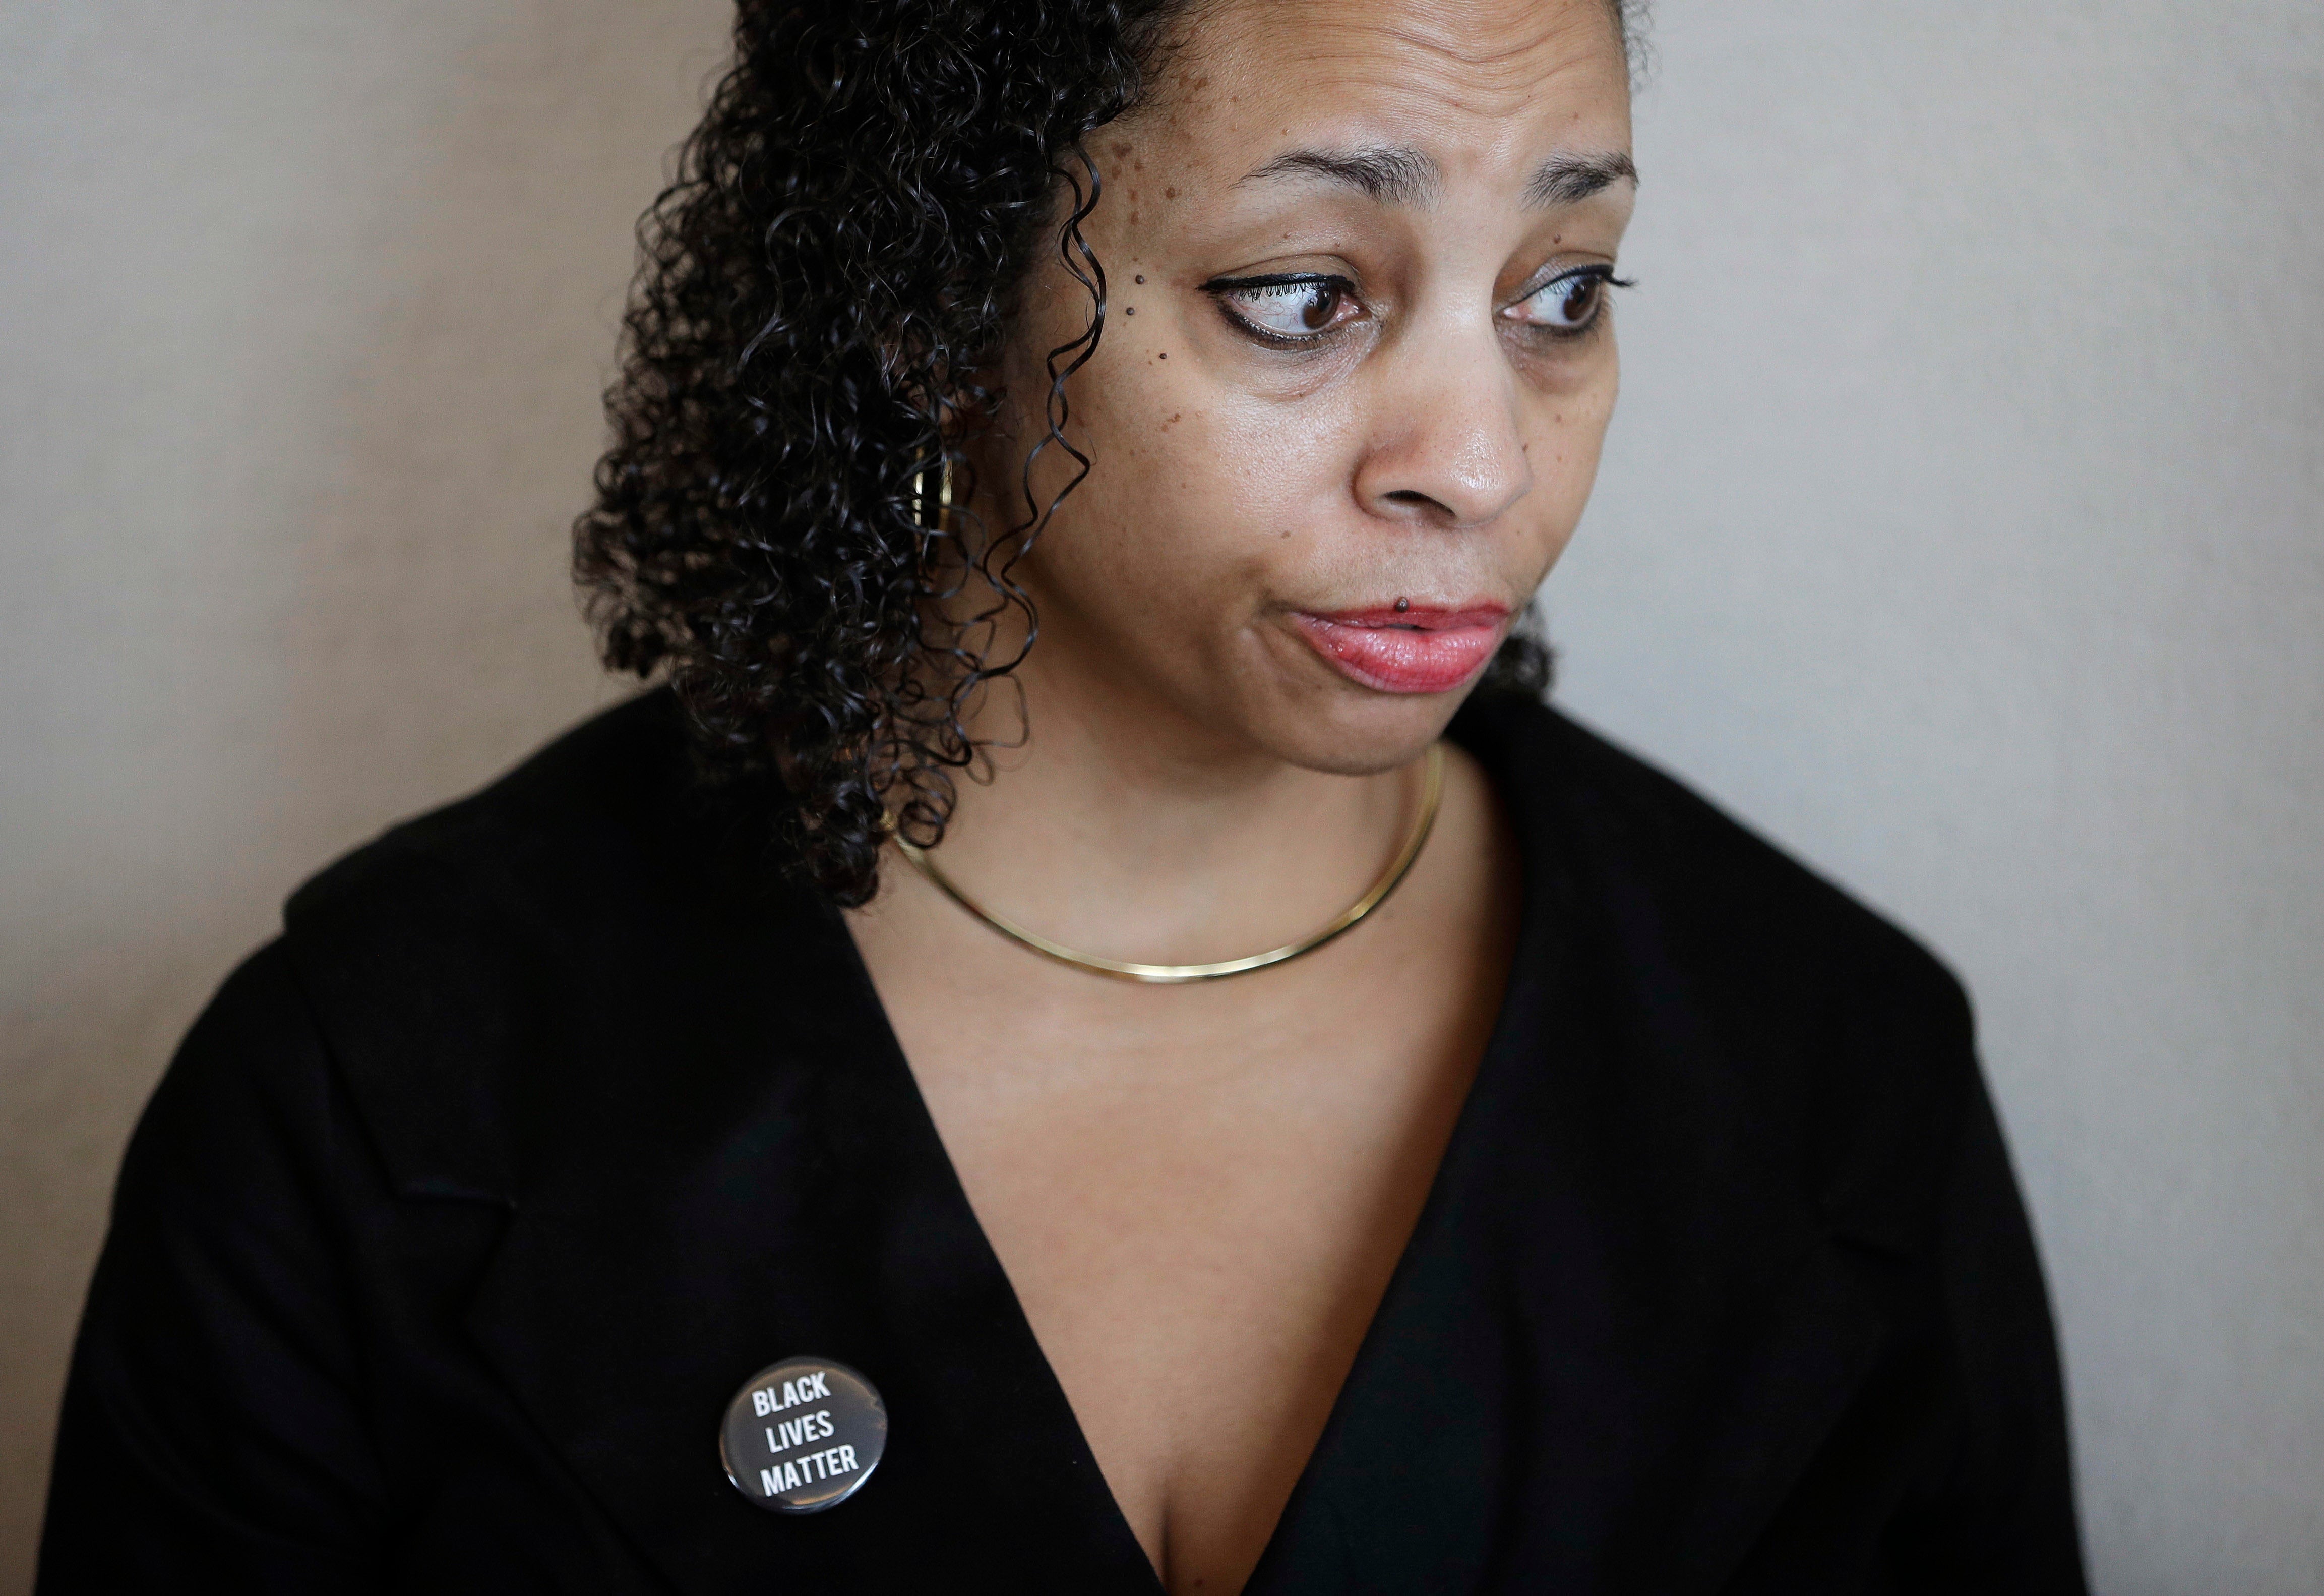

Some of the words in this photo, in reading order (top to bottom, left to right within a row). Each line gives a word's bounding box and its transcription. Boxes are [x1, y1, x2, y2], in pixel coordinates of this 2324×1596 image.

[752, 1371, 831, 1417] BLACK
[765, 1410, 834, 1453] LIVES
[760, 1444, 859, 1496] MATTER
